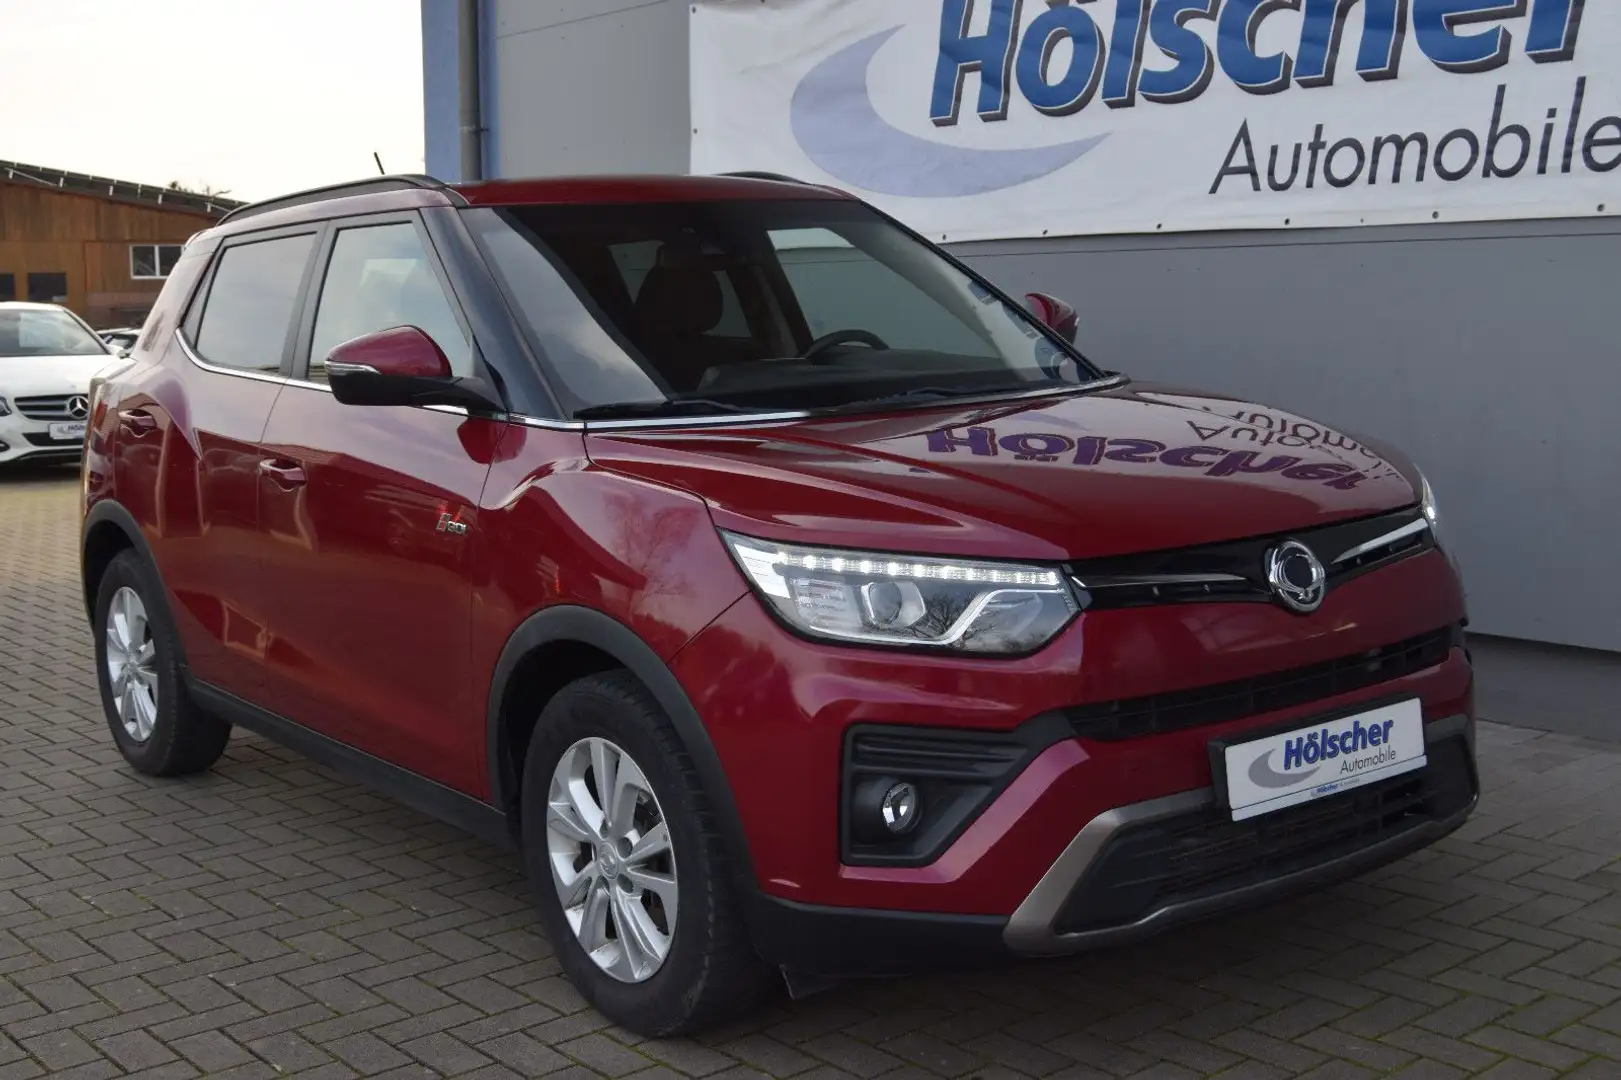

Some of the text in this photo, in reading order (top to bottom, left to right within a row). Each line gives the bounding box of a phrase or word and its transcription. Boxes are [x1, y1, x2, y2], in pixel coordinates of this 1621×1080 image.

[1209, 76, 1621, 195] Automobile
[1284, 719, 1394, 771] Hölscher
[1340, 745, 1397, 775] Automobile
